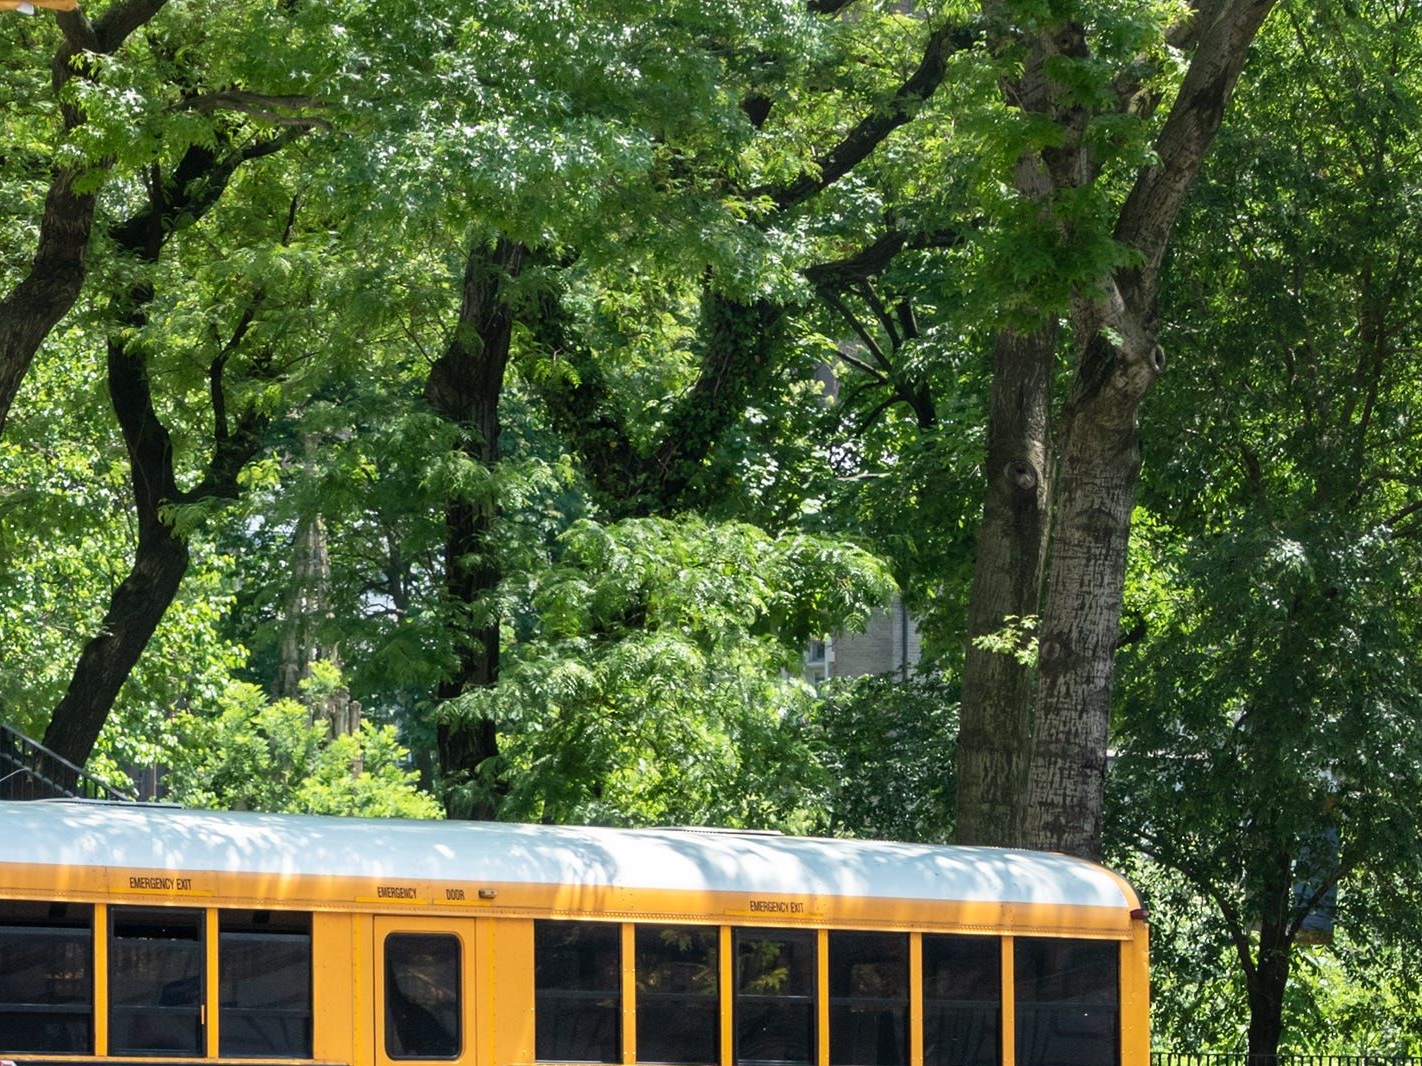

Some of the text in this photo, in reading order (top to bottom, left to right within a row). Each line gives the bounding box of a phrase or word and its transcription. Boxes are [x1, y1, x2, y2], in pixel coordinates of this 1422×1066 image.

[129, 877, 192, 891] EMERGENCY EXIT
[377, 887, 465, 900] EMERGENCY DOOR
[750, 901, 804, 913] EMERGENCY EXIT
